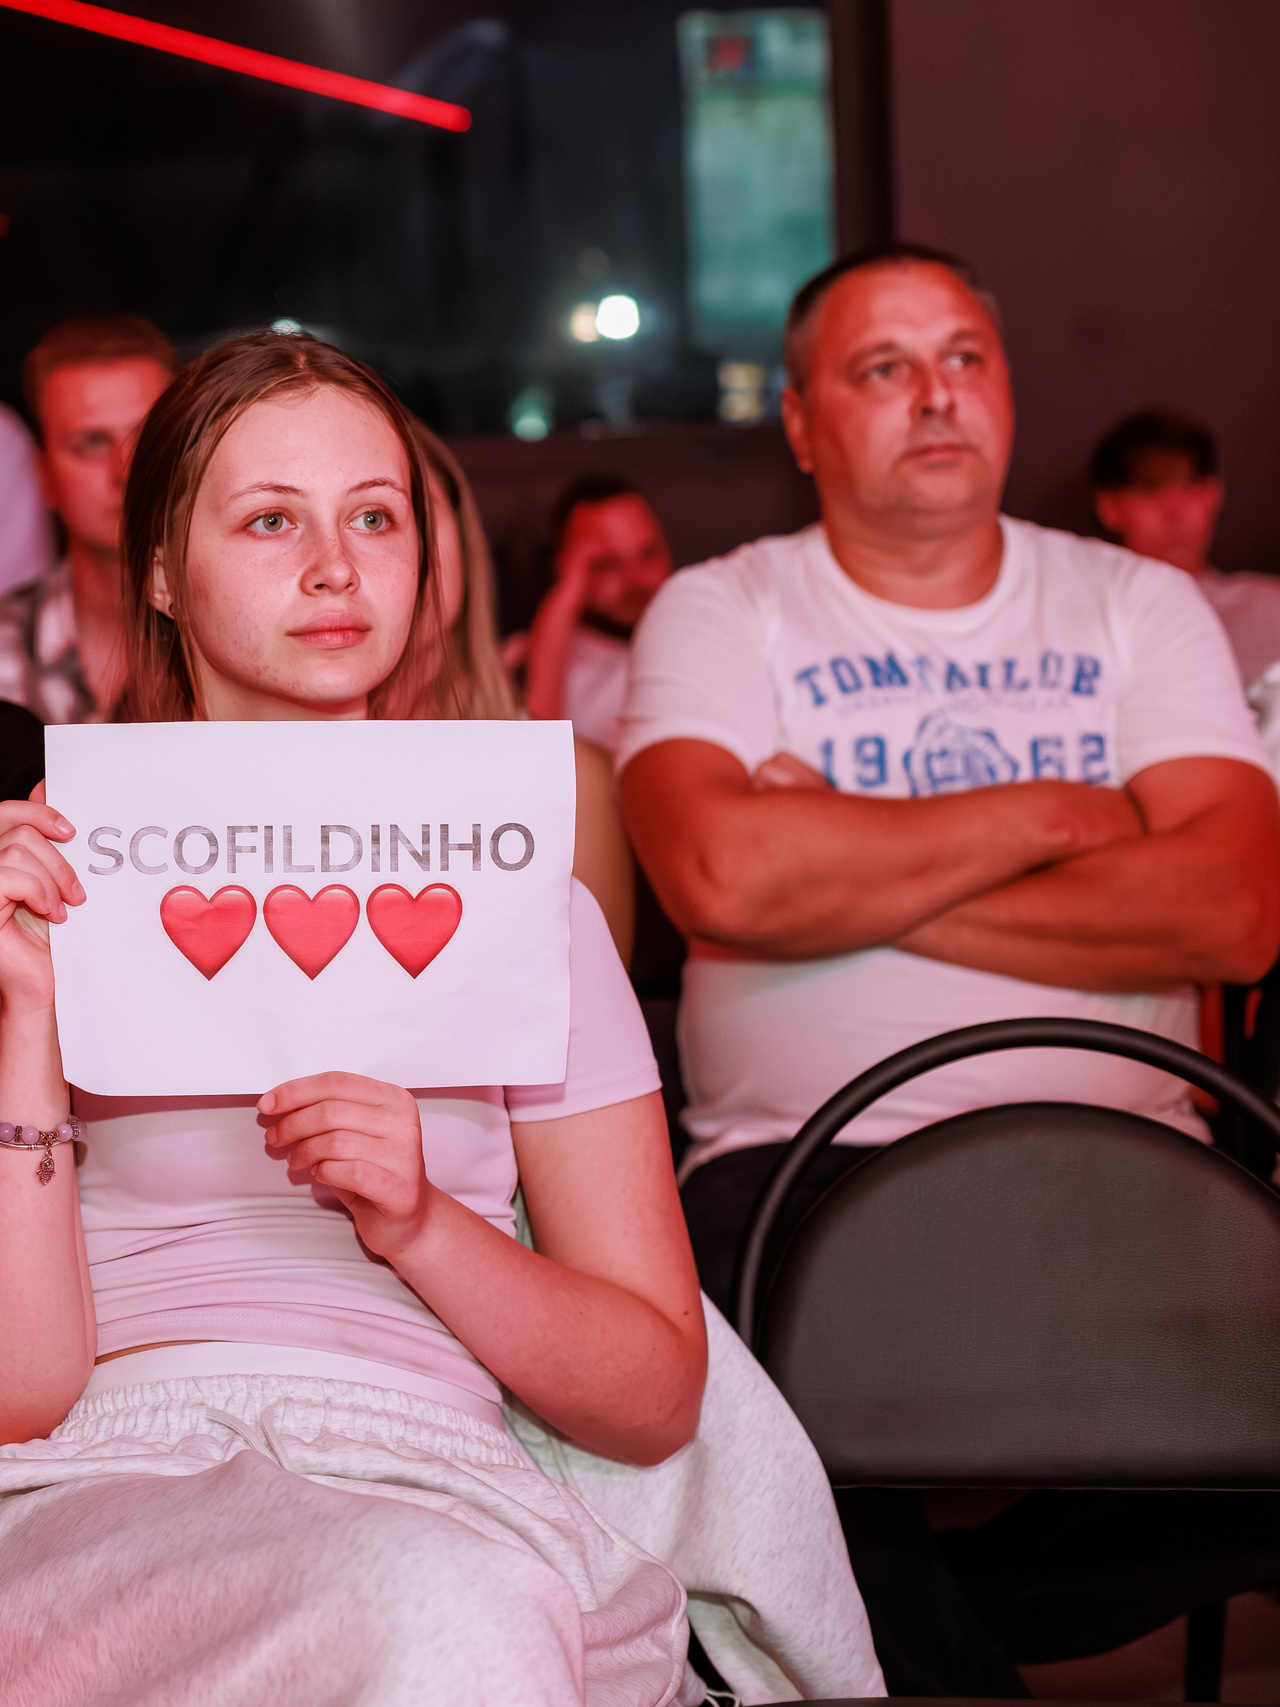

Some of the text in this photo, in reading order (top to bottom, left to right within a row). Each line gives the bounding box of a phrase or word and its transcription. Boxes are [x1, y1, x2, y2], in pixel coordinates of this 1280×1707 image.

[794, 649, 910, 707] TOM
[911, 649, 1102, 698] TAILOR
[818, 731, 1110, 791] 19 62
[86, 822, 536, 876] SCOFILDINHO
